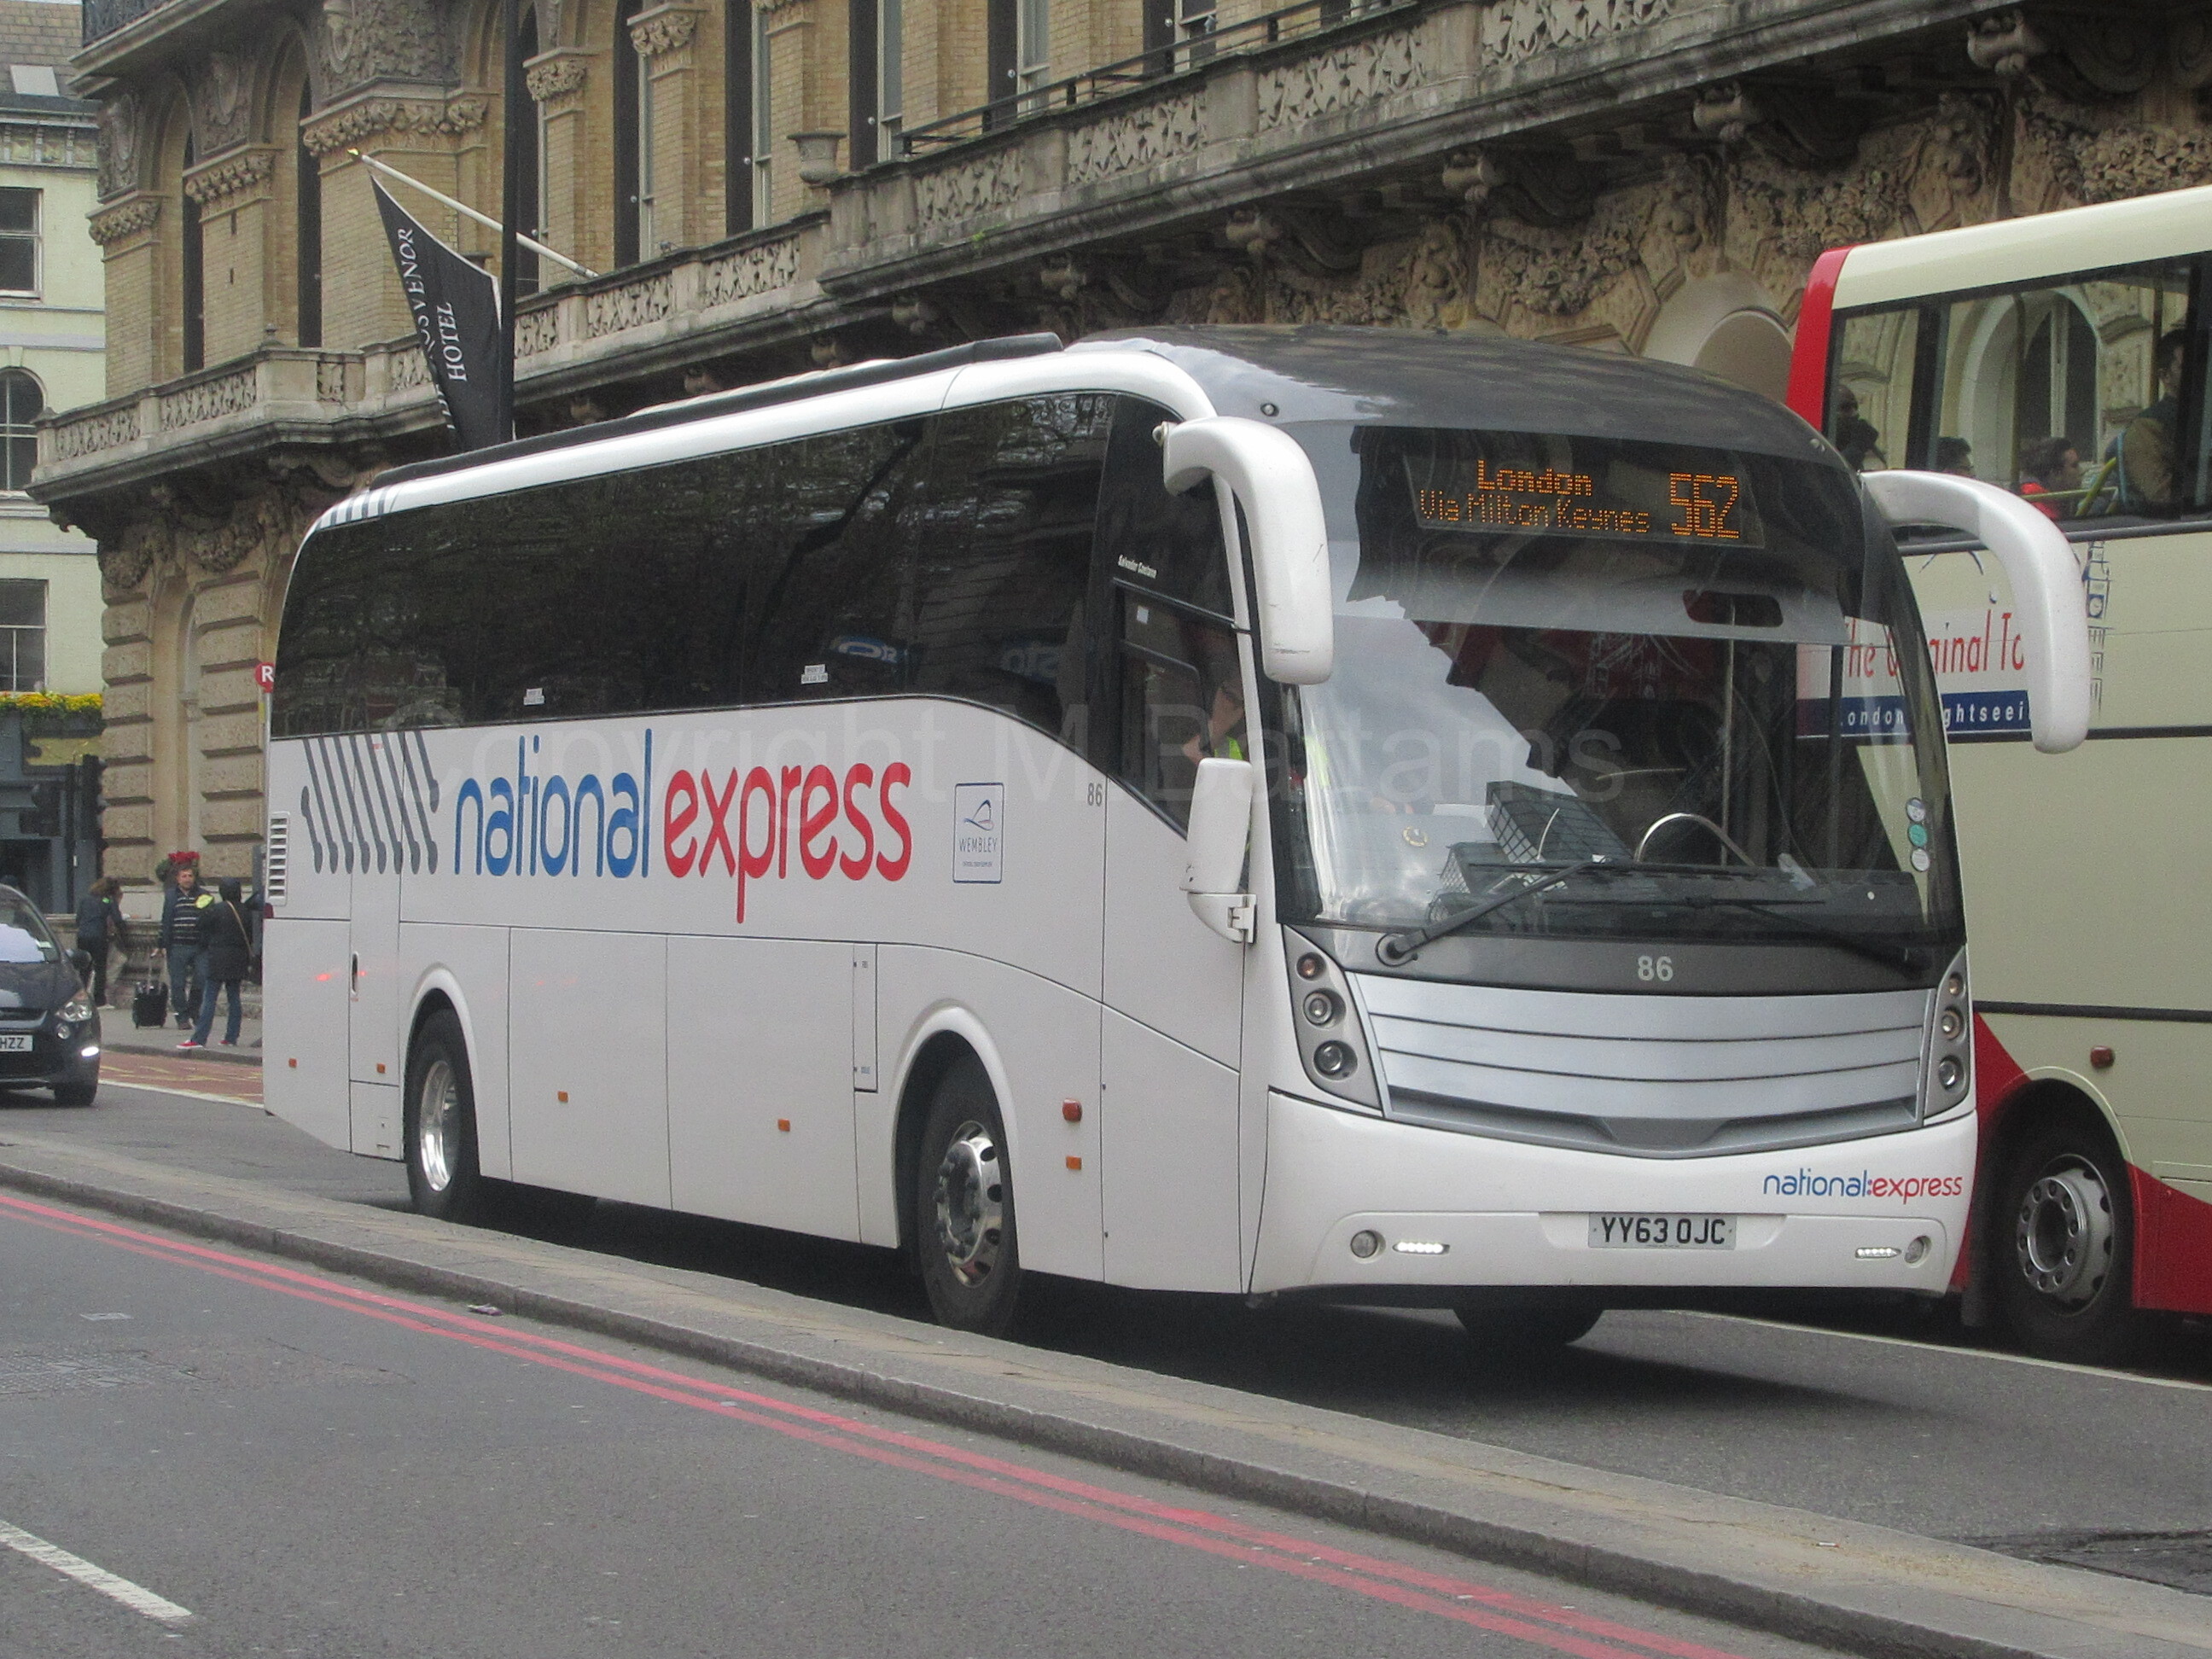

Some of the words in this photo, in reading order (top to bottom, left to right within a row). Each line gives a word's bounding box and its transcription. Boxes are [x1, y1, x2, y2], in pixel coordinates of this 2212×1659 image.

[437, 302, 468, 381] HOTEL
[1478, 459, 1592, 497] London
[1420, 489, 1460, 521] Via
[1467, 492, 1550, 528] Milton
[1557, 498, 1650, 533] Keynes
[1670, 473, 1739, 538] 562
[1843, 617, 1877, 678] he
[261, 665, 275, 683] R
[1840, 707, 1904, 726] ondon
[1943, 700, 2030, 729] ghtseei
[1087, 783, 1103, 806] 86
[454, 728, 653, 879] national
[664, 762, 912, 924] express
[959, 836, 998, 853] WEMBLEY
[1638, 955, 1674, 981] 86
[1601, 1216, 1668, 1243] YY63
[1676, 1218, 1726, 1244] OJC
